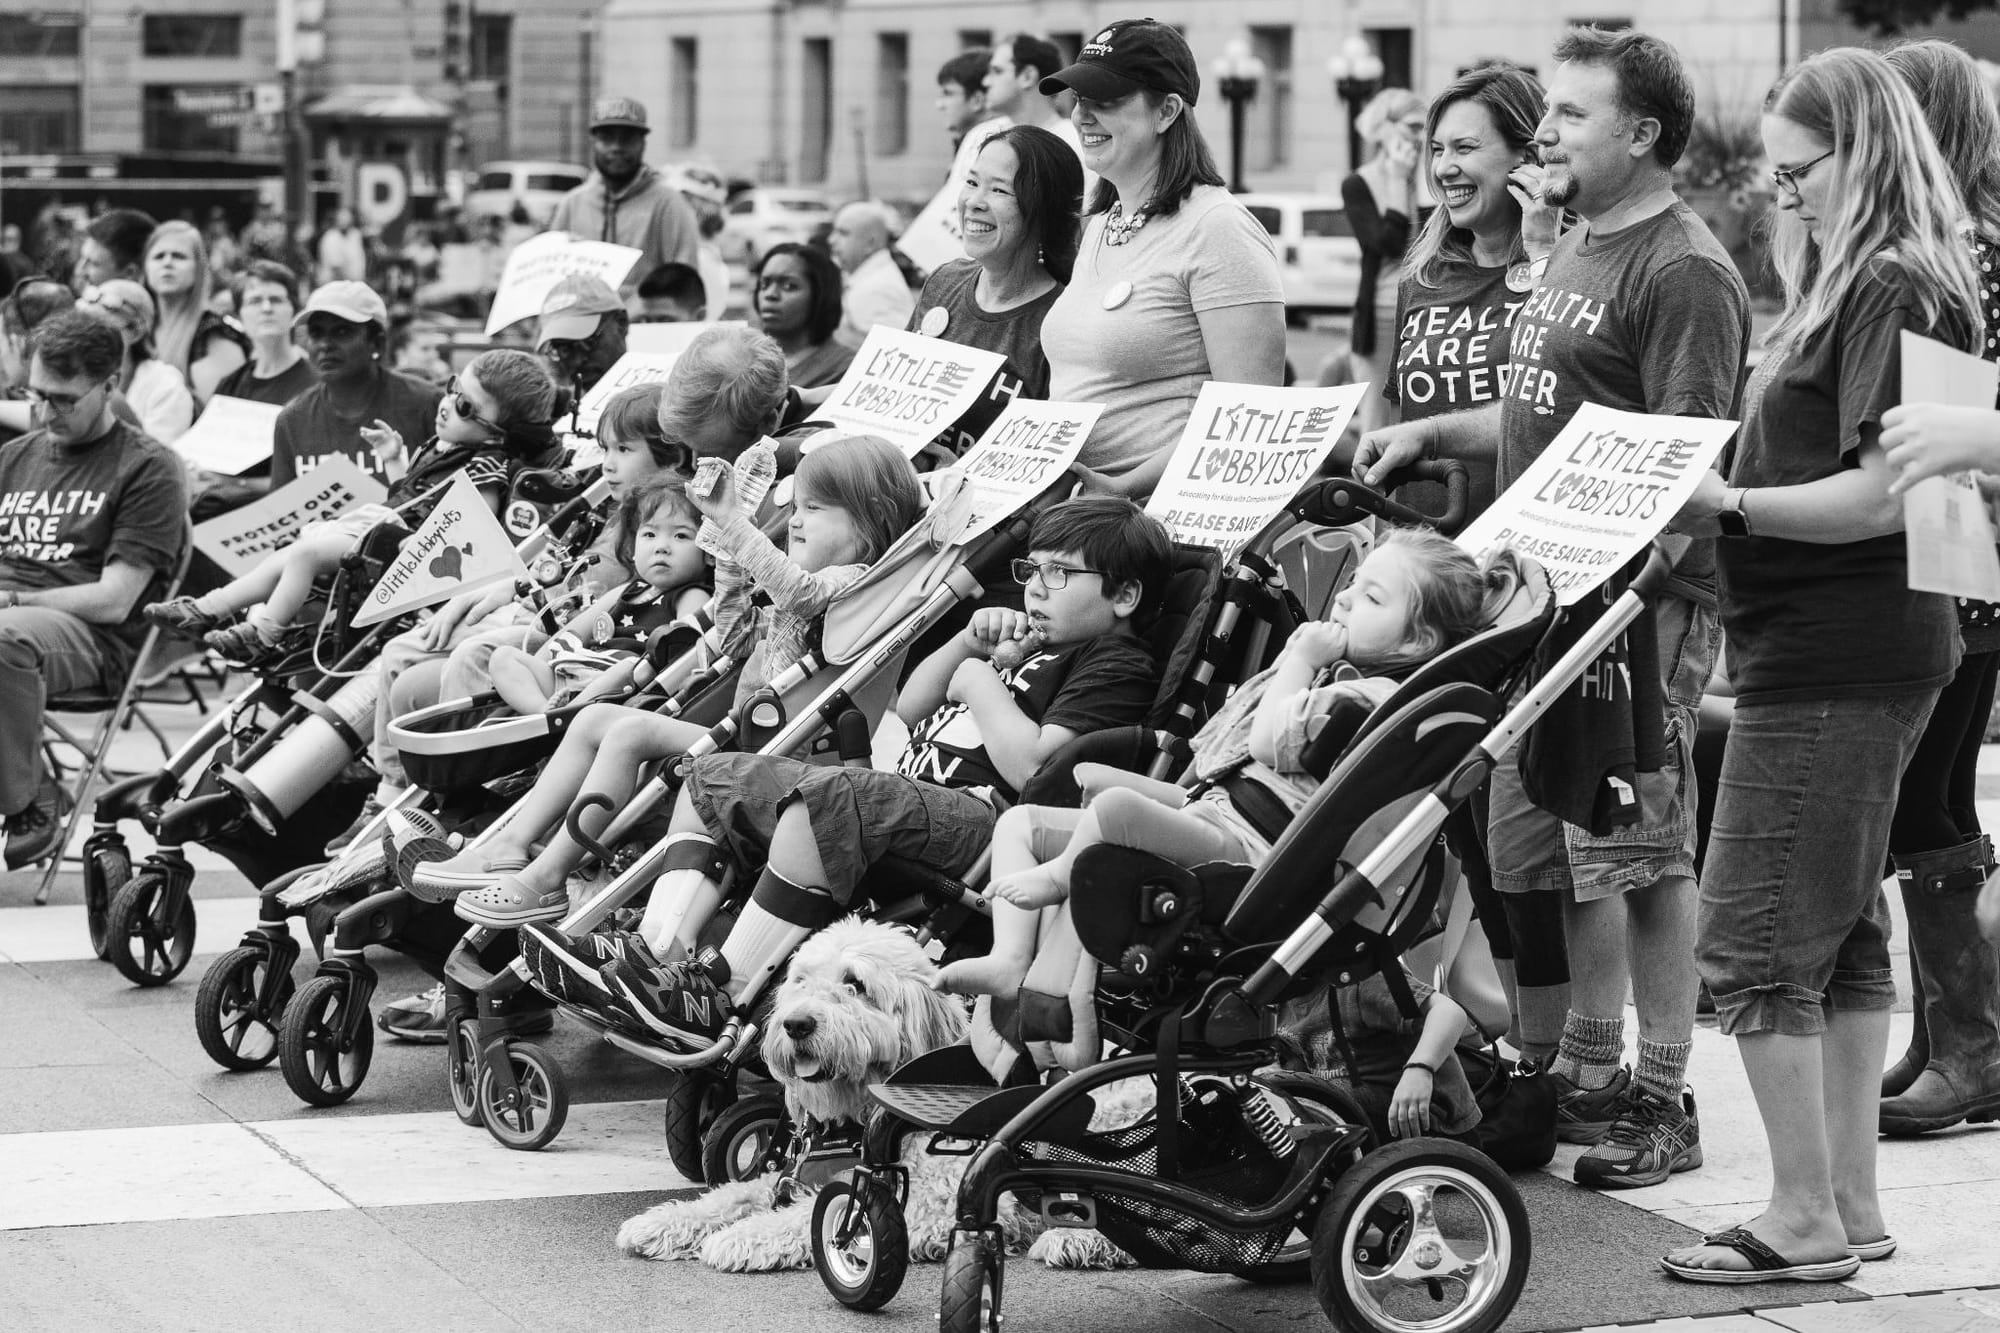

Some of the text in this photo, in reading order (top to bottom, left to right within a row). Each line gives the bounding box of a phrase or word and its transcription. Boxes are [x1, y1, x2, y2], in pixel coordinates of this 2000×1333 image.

[1401, 302, 1525, 340] HEALT
[1520, 287, 1606, 336] EALTH
[1510, 322, 1549, 361] ARE
[865, 347, 943, 389] LITTLE
[1508, 363, 1558, 407] TER
[841, 380, 949, 425] LOBBYISTS
[991, 416, 1059, 451] LITTLE
[1205, 403, 1305, 445] LITTLE
[964, 449, 1056, 485] LOBBYISTS
[1187, 446, 1317, 486] LOBBYISTS
[1566, 430, 1665, 475] LITTLE
[0, 490, 106, 516] HEALTH
[308, 492, 355, 524] ARE
[1534, 468, 1670, 520] LOBBYISTS
[221, 482, 343, 548] PROTECT OUR
[1163, 509, 1226, 531] PLEASE
[1226, 515, 1261, 532] SAVE
[1493, 527, 1558, 558] PLEASE
[1554, 544, 1593, 563] SAVE
[1588, 550, 1619, 566] OUR
[594, 934, 626, 961] N
[682, 990, 711, 1027] N
